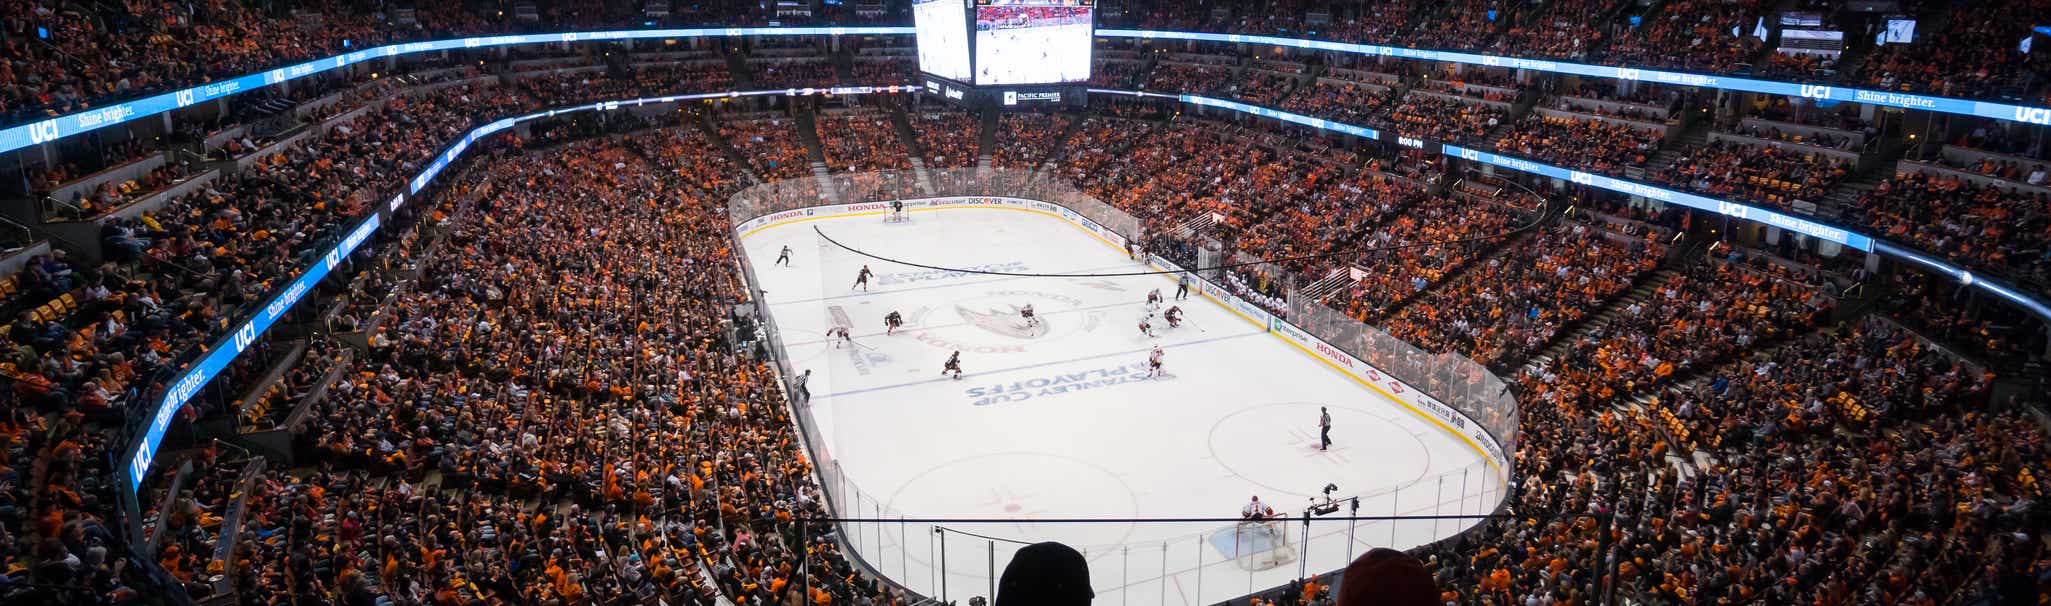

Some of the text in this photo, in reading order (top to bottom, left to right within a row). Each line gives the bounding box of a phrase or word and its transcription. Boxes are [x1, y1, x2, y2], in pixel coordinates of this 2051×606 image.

[464, 38, 480, 47] UCI
[562, 33, 577, 41] UCI
[1379, 47, 1392, 56] UCI
[1482, 56, 1499, 66] UCI
[1617, 68, 1639, 80] UCI
[1658, 71, 1680, 81] Shine
[176, 89, 193, 107] UCI
[205, 86, 220, 97] Shine
[1800, 84, 1936, 108] UCI Shine brighter.
[30, 104, 135, 144] UCI Shine brighter.
[2015, 106, 2050, 125] UCI
[1461, 148, 1478, 161] UCI
[1570, 170, 1592, 185] UCI
[1610, 180, 1634, 194] Shine
[770, 210, 803, 222] HONDA
[847, 203, 886, 212] HONDA
[1718, 200, 1842, 240] UCI Shine brighter.
[326, 248, 340, 271] UCI
[1206, 284, 1230, 302] DISCOVER
[234, 280, 306, 353] UCI Shine brighter.
[1316, 342, 1353, 369] HONDA
[965, 365, 1129, 398] PLAYOFFS
[973, 371, 1154, 406] STANLEY CUP
[132, 436, 151, 483] UCI
